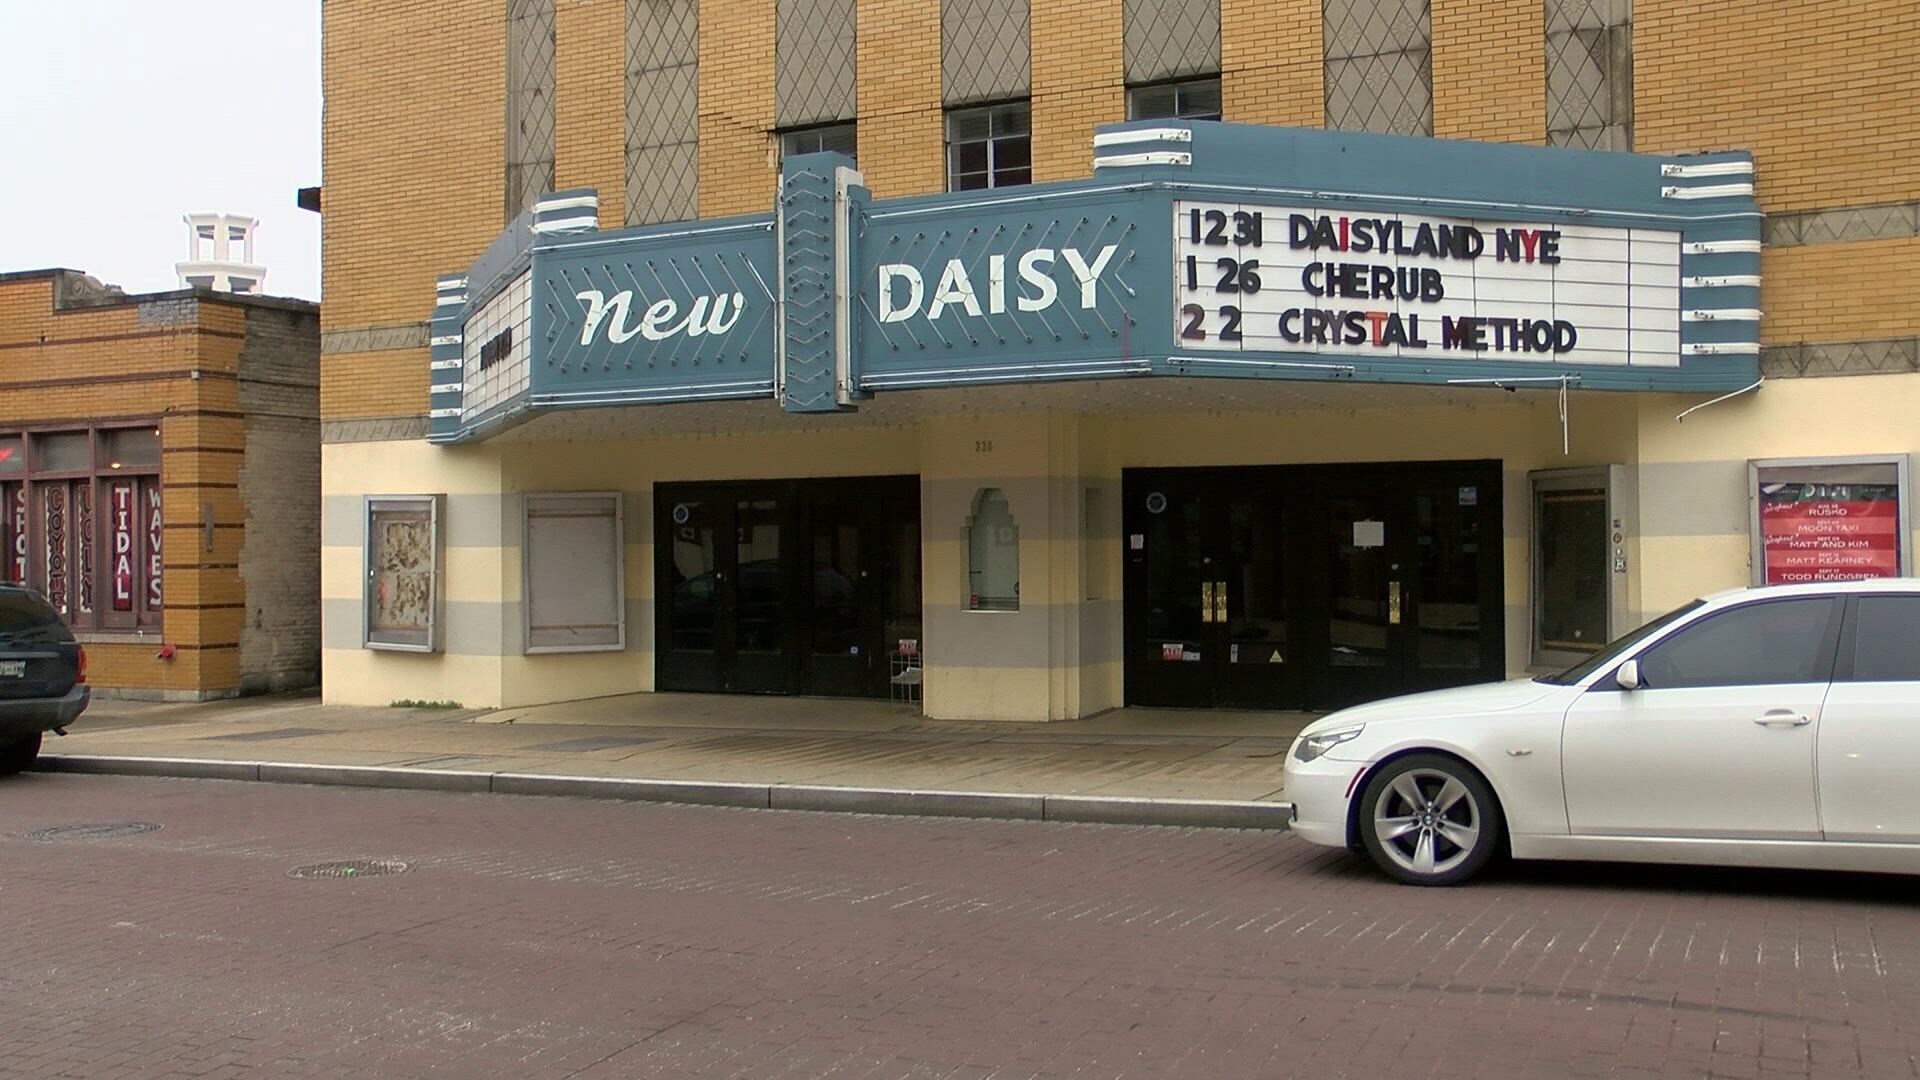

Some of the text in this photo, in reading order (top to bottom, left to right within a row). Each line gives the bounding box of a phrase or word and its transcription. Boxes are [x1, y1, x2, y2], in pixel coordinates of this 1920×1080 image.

[1289, 213, 1484, 261] DAISYLAND
[1496, 227, 1562, 264] NYE
[877, 244, 1120, 324] DAISY
[1216, 258, 1261, 294] 26
[1302, 262, 1444, 302] CHERUB
[1279, 307, 1428, 349] CRYSTAL
[1442, 315, 1578, 353] METHOD
[1808, 508, 1848, 516] RUSKO
[115, 488, 129, 600] TIDAL
[1786, 557, 1873, 565] MATT KEARNEY
[1789, 541, 1820, 549] MATT
[1781, 573, 1811, 581] TODD
